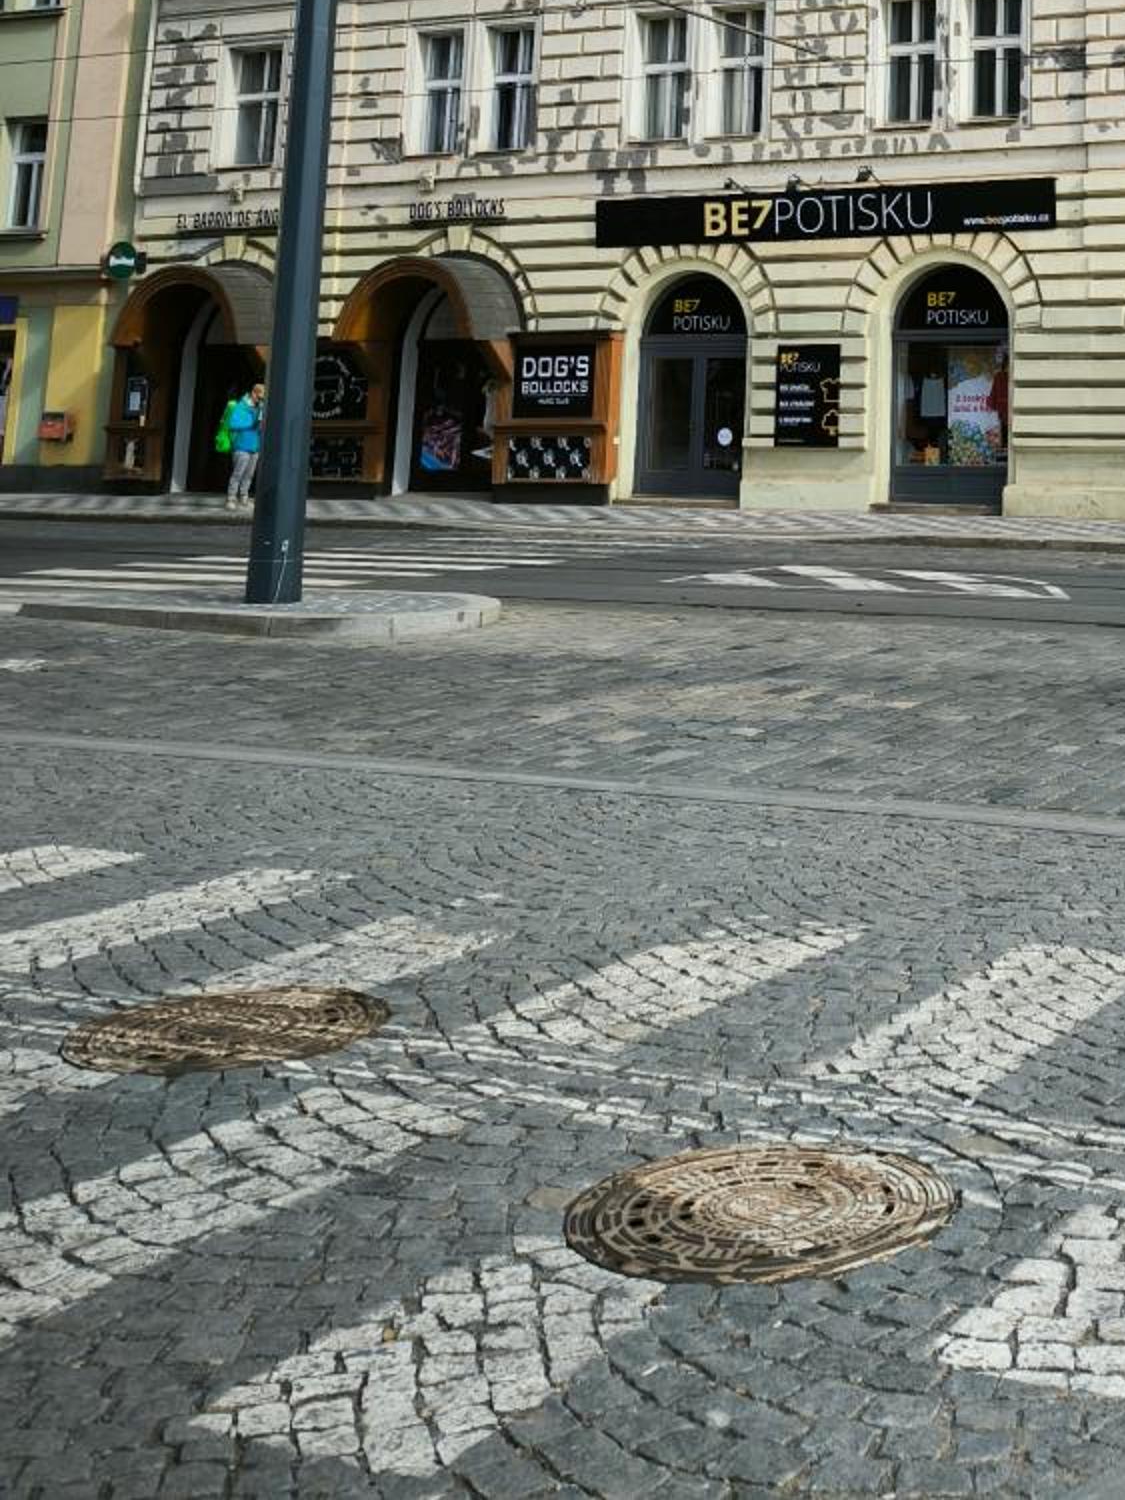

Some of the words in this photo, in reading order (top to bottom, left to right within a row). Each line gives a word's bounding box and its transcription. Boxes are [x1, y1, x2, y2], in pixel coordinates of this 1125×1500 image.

[447, 197, 505, 217] BOLLOCKS
[672, 314, 731, 332] POTISKU
[926, 308, 990, 325] POTISKU
[521, 355, 590, 379] DOG'S
[520, 380, 589, 395] BOLLOCKS
